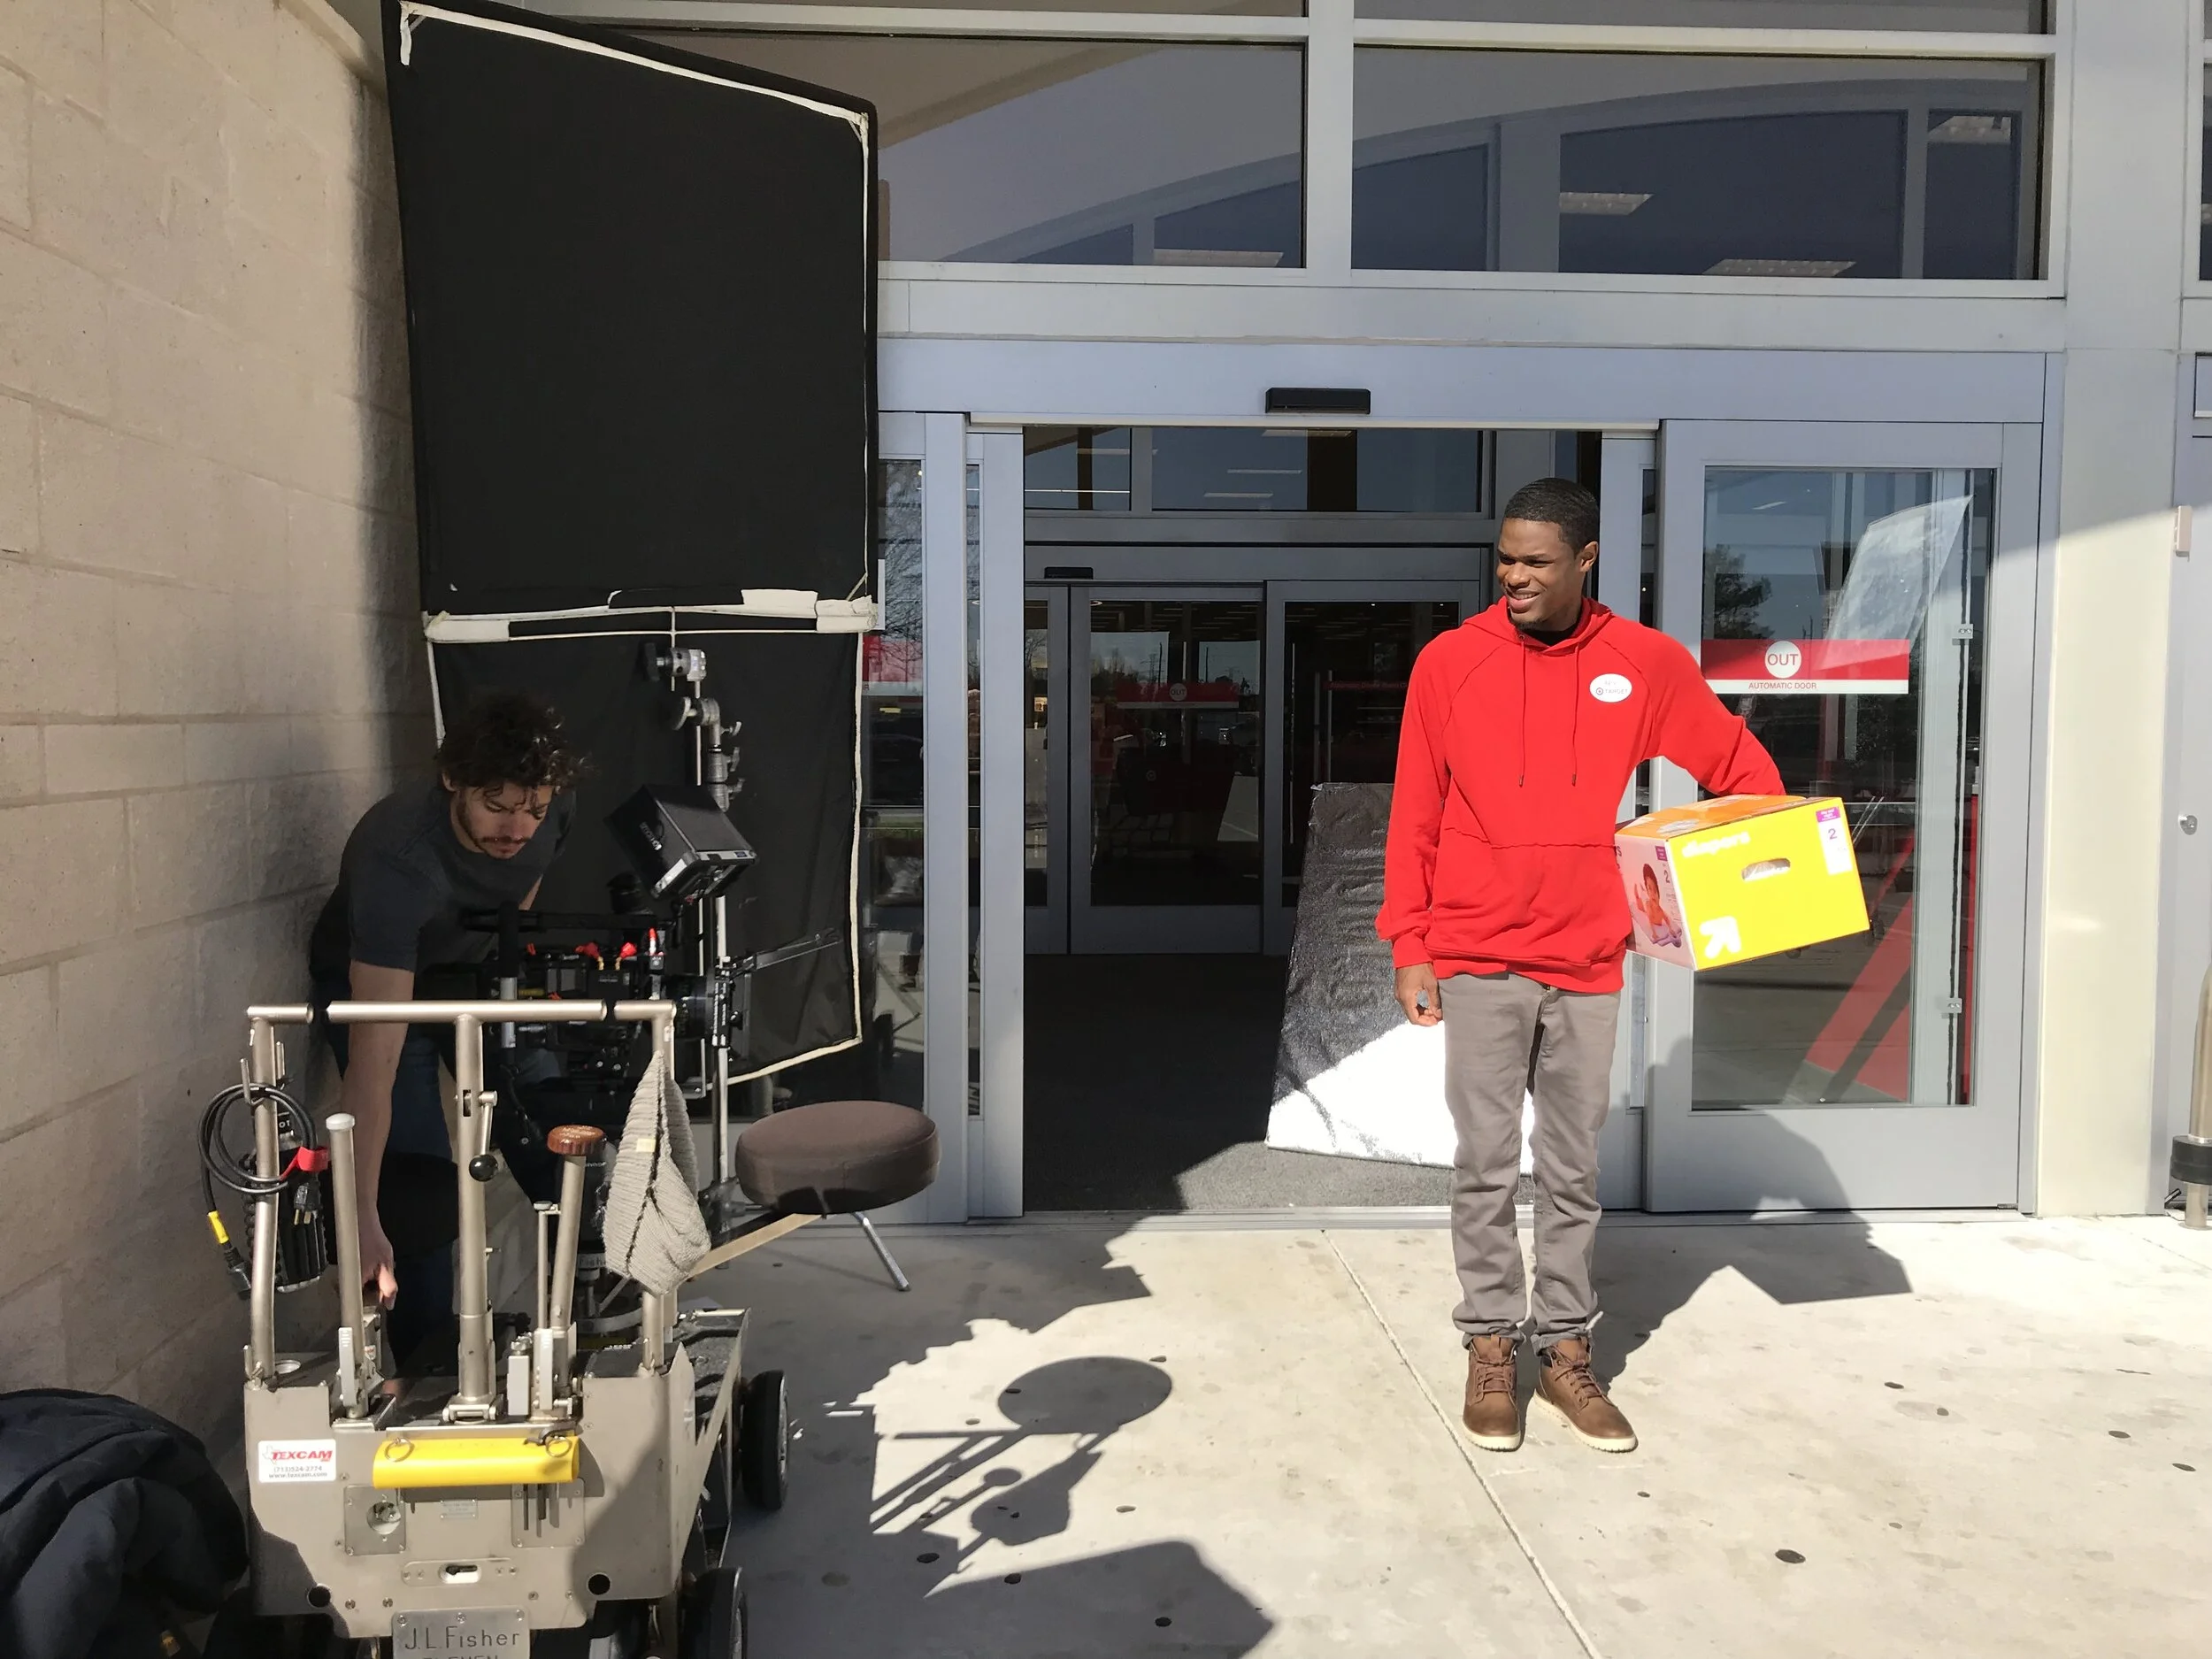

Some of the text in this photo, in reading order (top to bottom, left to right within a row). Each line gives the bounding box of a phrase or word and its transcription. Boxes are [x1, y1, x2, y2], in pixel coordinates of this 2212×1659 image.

[1767, 653, 1799, 666] OUT
[1828, 828, 1838, 840] 2
[1664, 870, 1671, 883] 2
[273, 1450, 333, 1460] TEXCAM
